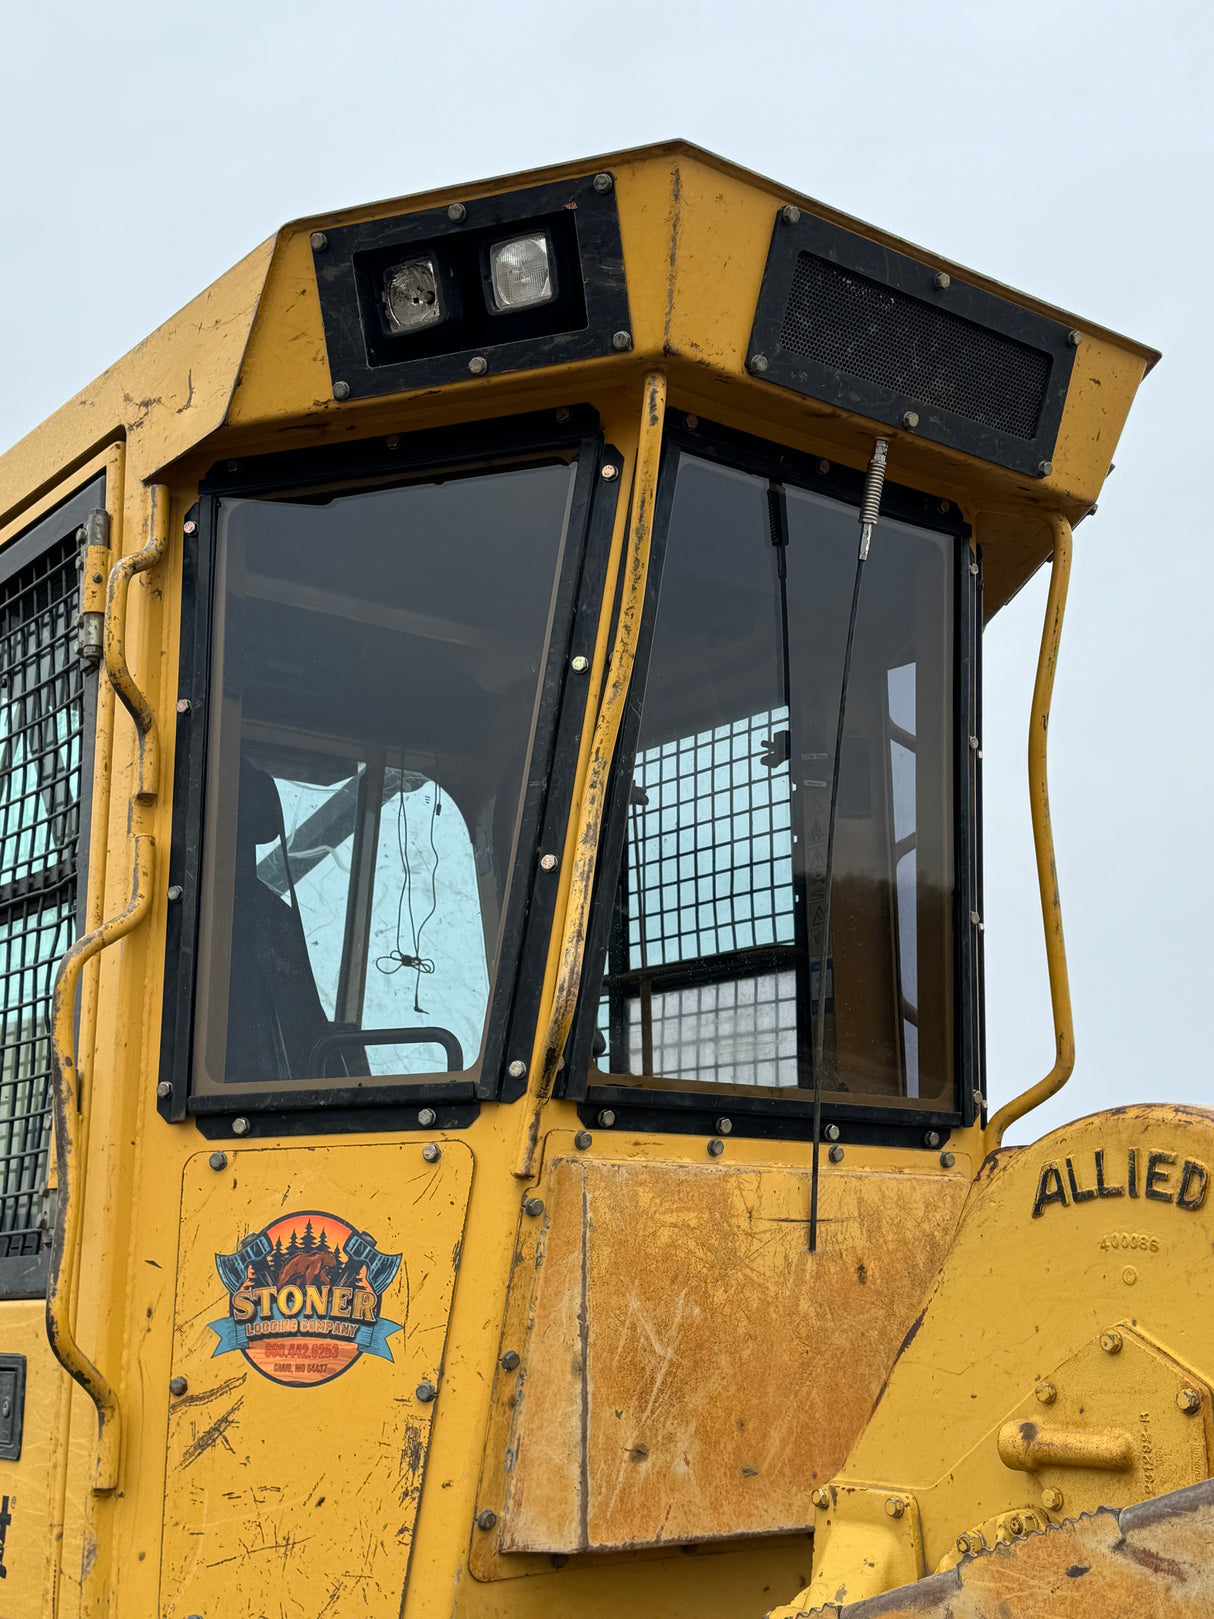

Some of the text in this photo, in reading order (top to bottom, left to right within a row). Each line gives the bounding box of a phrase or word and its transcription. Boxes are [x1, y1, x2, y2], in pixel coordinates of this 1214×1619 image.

[1032, 1147, 1211, 1219] ALLIED
[233, 1286, 377, 1322] STONER
[246, 1320, 359, 1337] LOGGING COMPANY
[294, 1363, 306, 1373] MO
